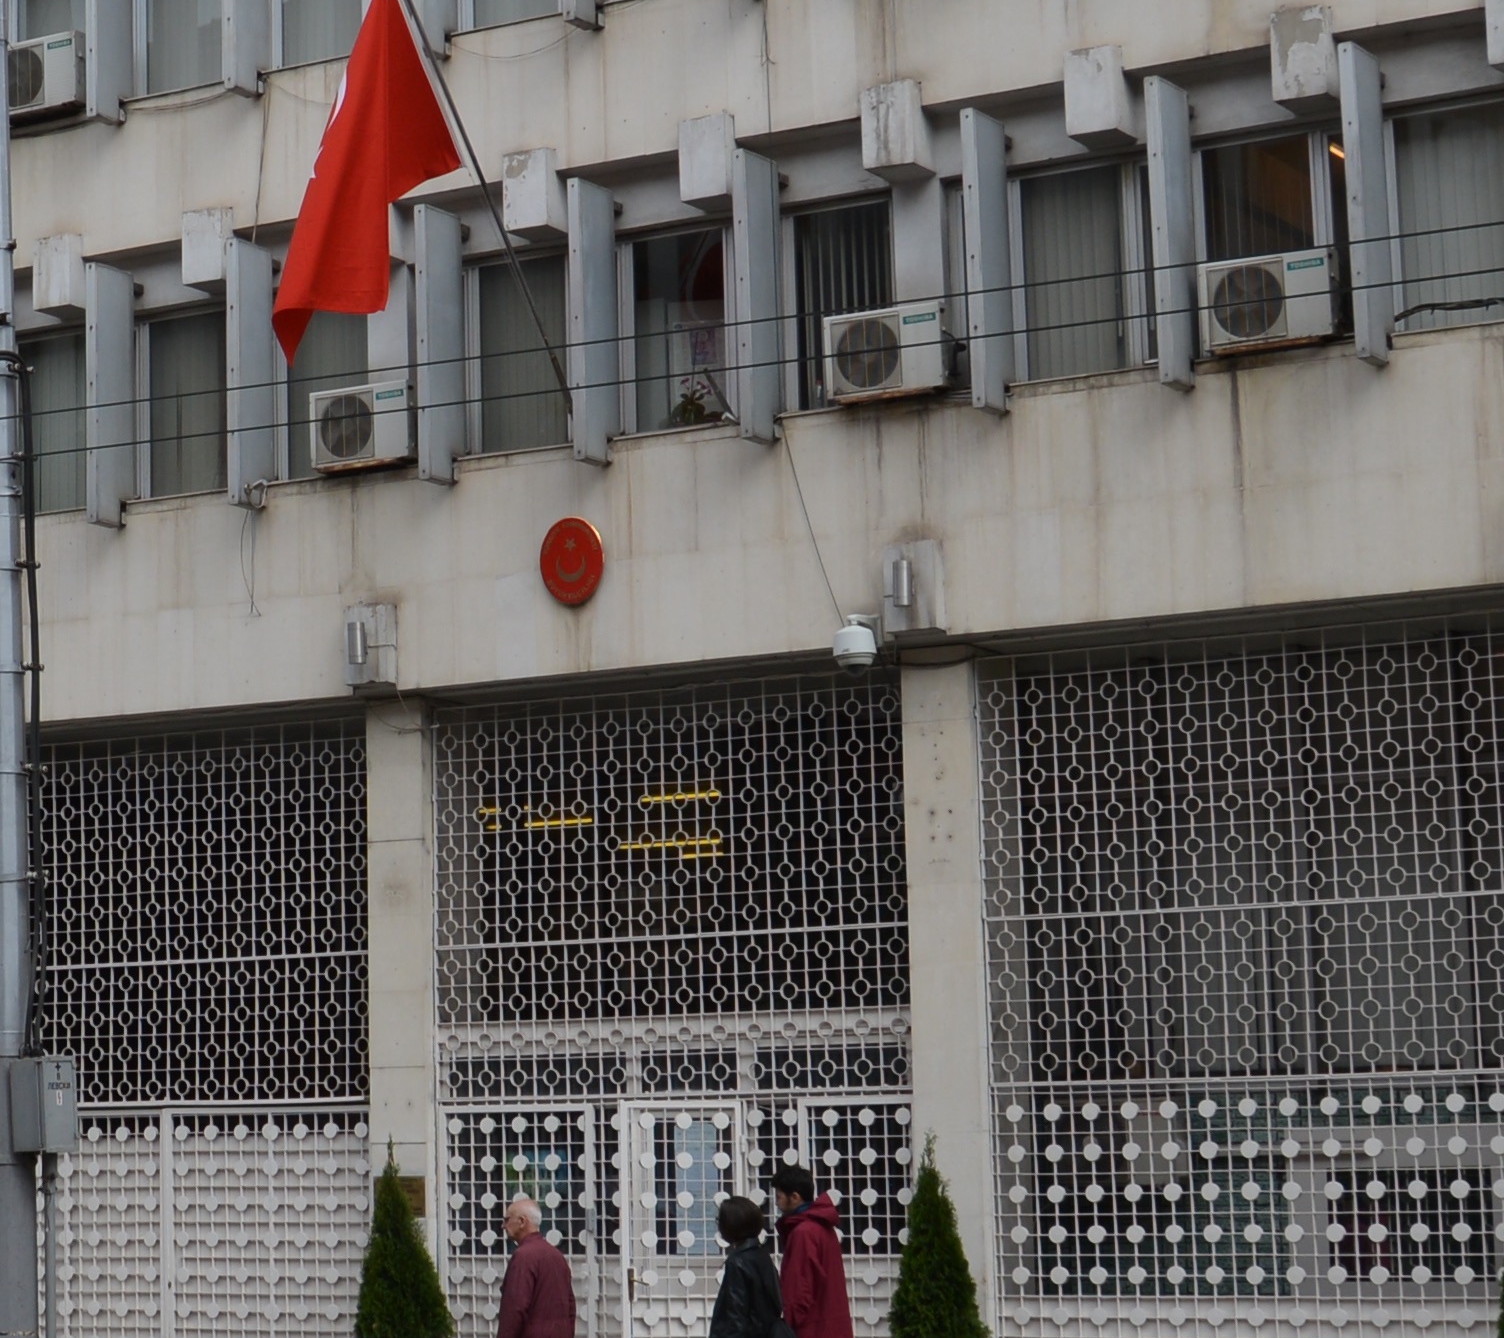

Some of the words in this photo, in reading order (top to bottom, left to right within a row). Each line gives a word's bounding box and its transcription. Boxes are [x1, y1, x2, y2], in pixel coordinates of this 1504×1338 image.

[49, 39, 71, 49] TOSHIBA
[1289, 259, 1322, 270] TOSHIBA
[906, 314, 934, 323] TOSHIBA
[378, 390, 402, 399] TOSHIBA
